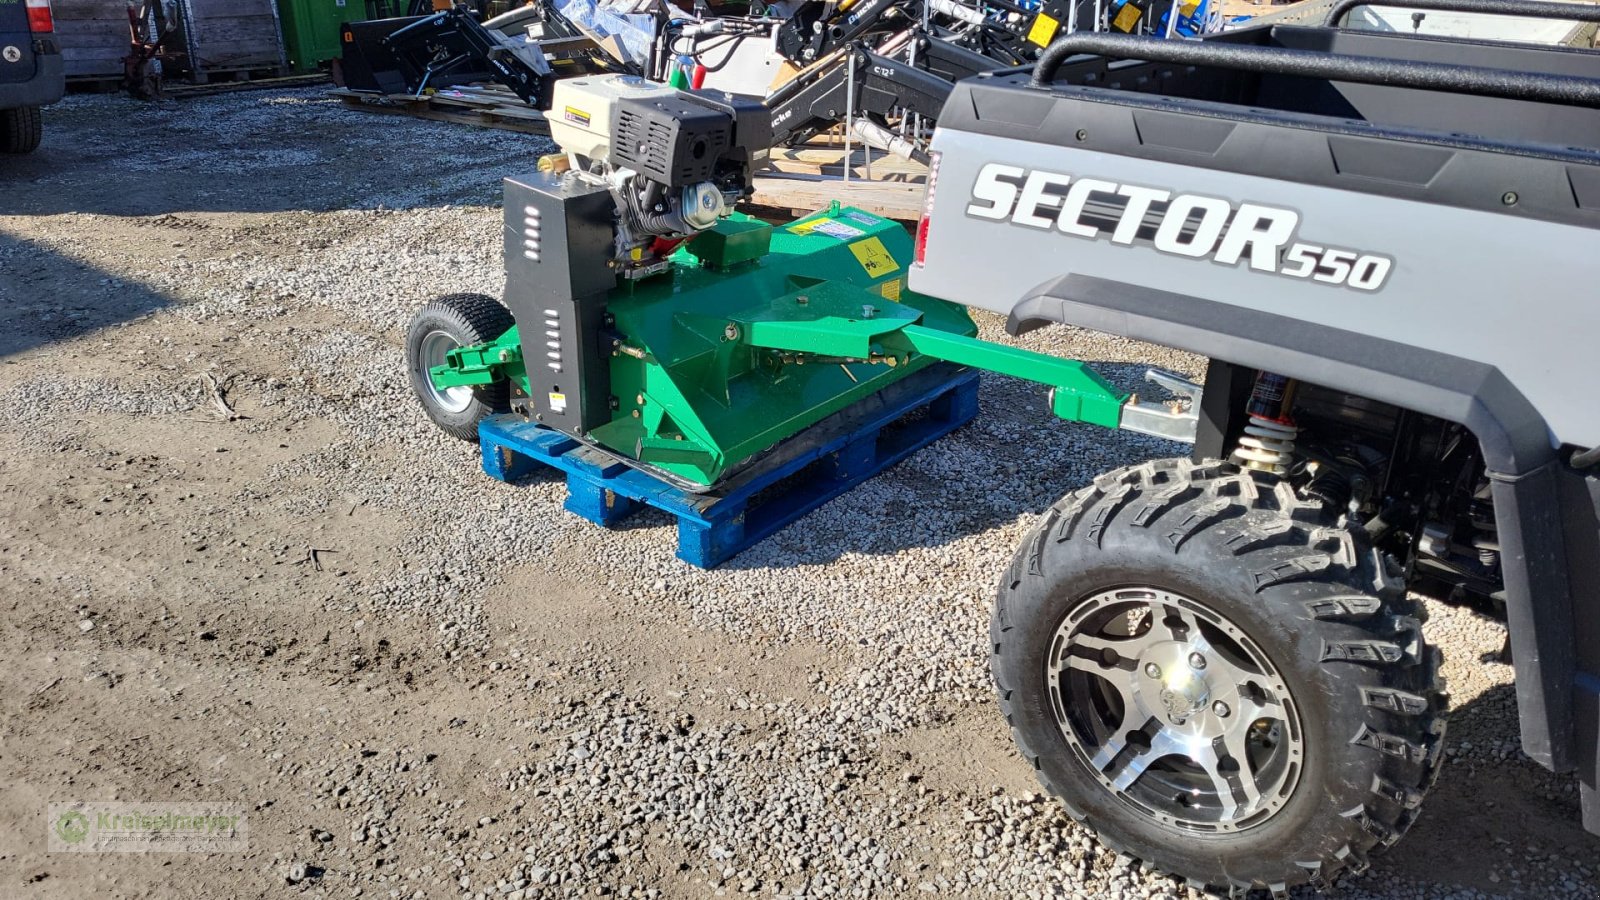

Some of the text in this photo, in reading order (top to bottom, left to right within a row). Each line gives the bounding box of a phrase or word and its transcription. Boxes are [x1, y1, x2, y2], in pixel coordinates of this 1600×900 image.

[771, 110, 792, 128] icke
[967, 163, 1391, 290] SECTOR 550
